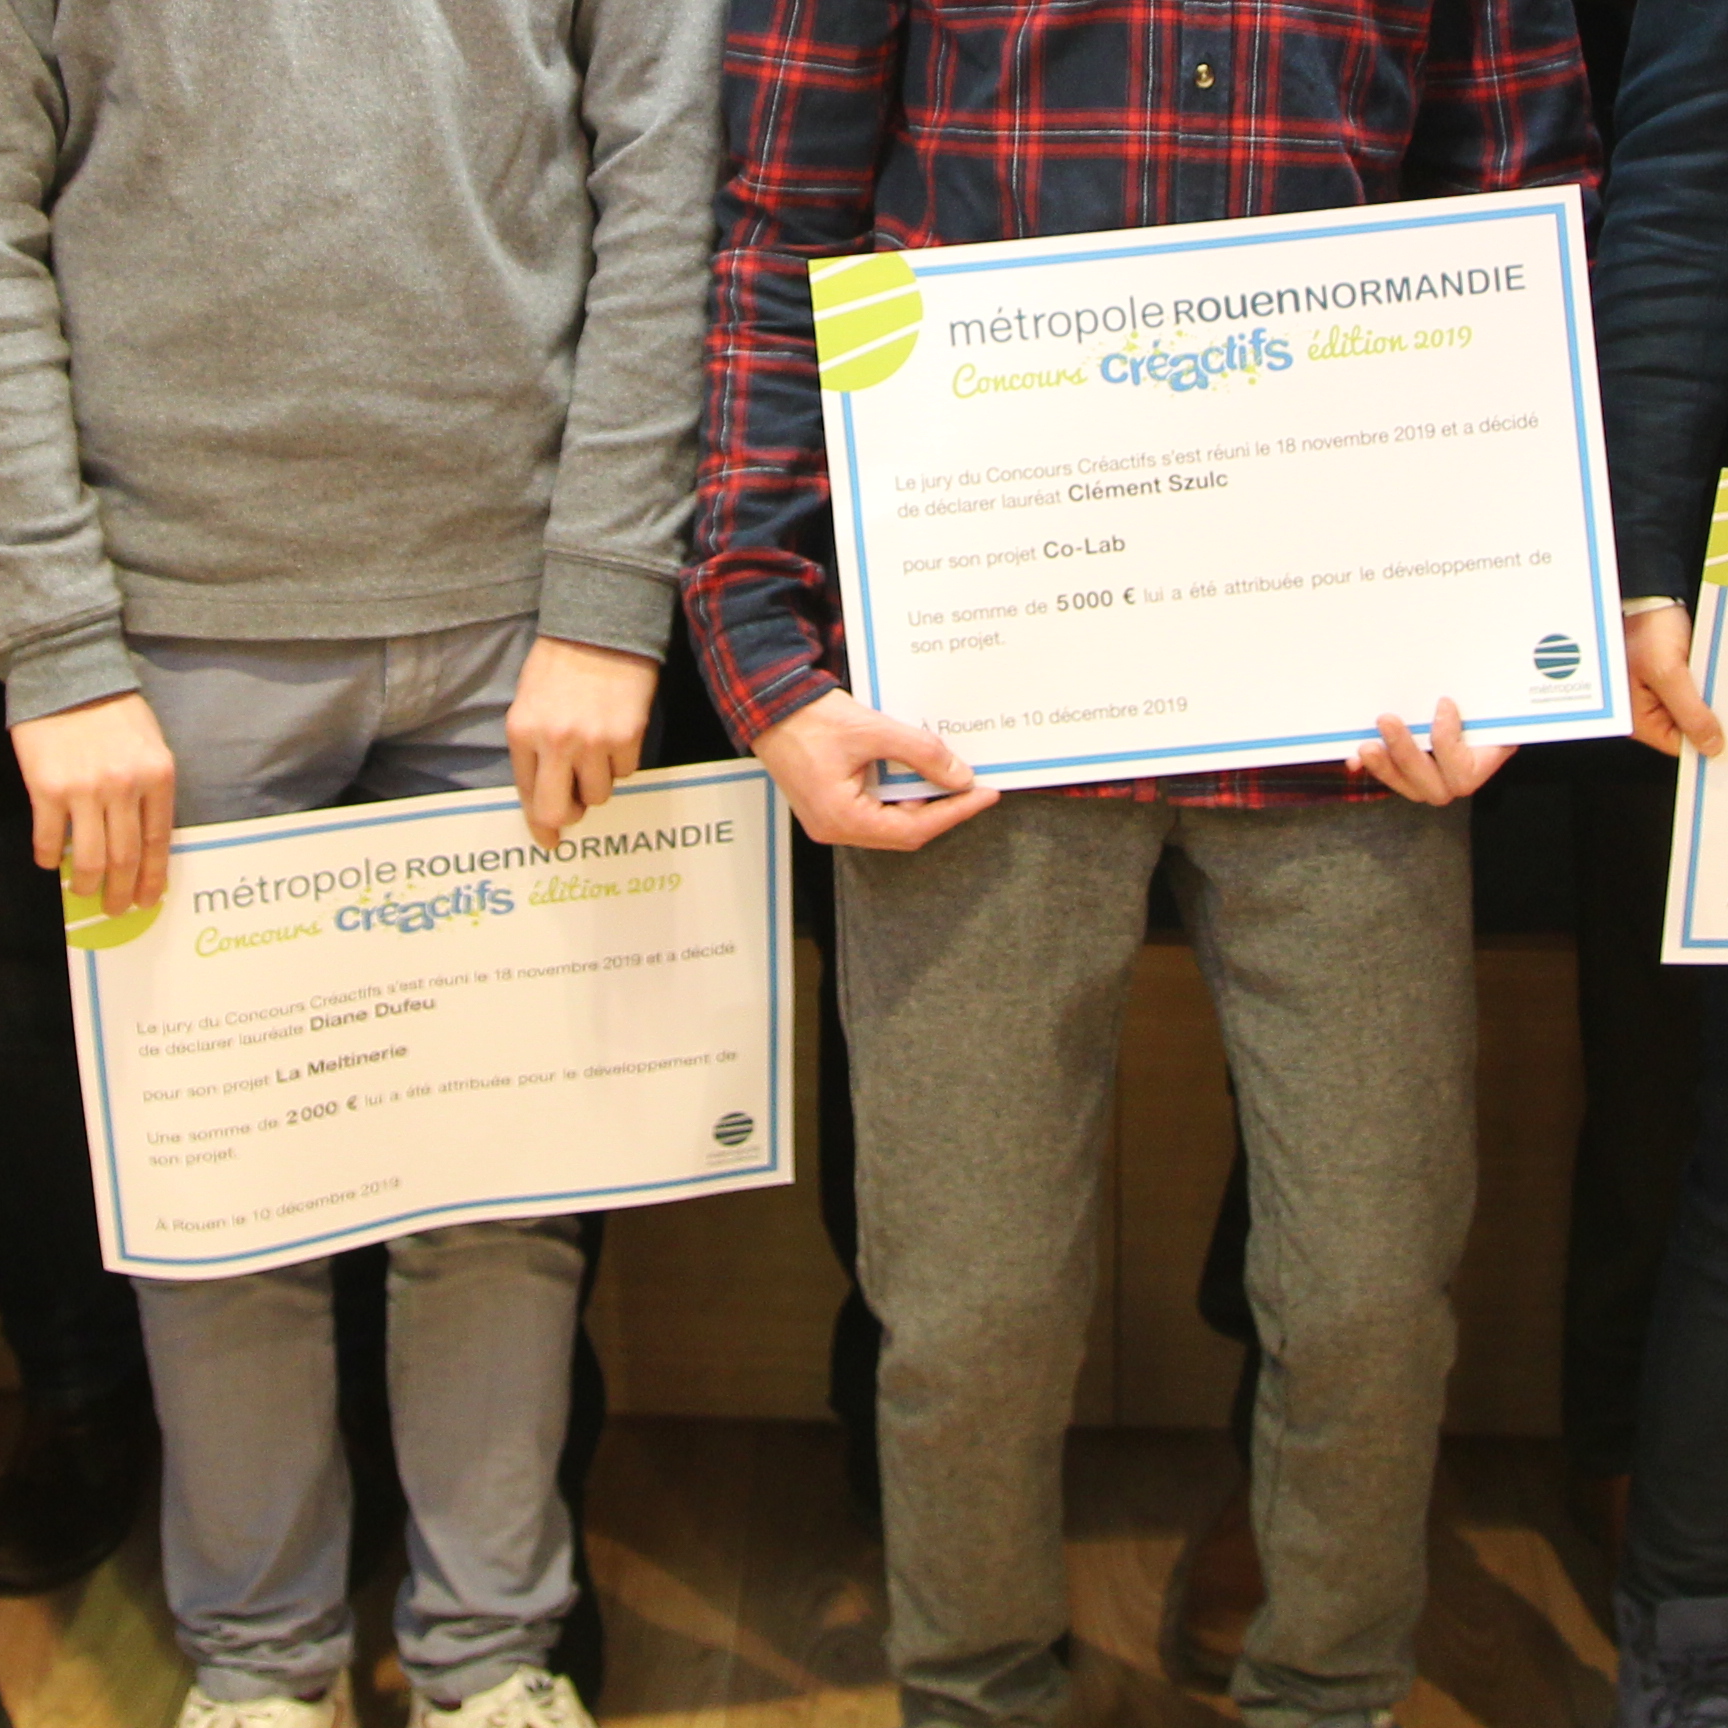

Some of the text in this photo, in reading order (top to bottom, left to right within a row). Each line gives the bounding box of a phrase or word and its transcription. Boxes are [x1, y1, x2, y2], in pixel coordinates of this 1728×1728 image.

[949, 296, 1164, 347] métropole
[952, 324, 1474, 400] Concours créactifs édition 2019
[895, 411, 1540, 494] Le jury du Concours Créactifs s'est réuni le 18 novembre 2019 et a décidé
[898, 469, 1228, 518] de déclarer lauréat Clément Szulc
[902, 532, 1127, 574] pour son projet Co-Lab
[193, 857, 398, 914] métropole
[194, 872, 683, 958] Concours créactifs édition 2019
[309, 997, 438, 1032] Diane Dufeu
[275, 1044, 410, 1084] La Meltinerie
